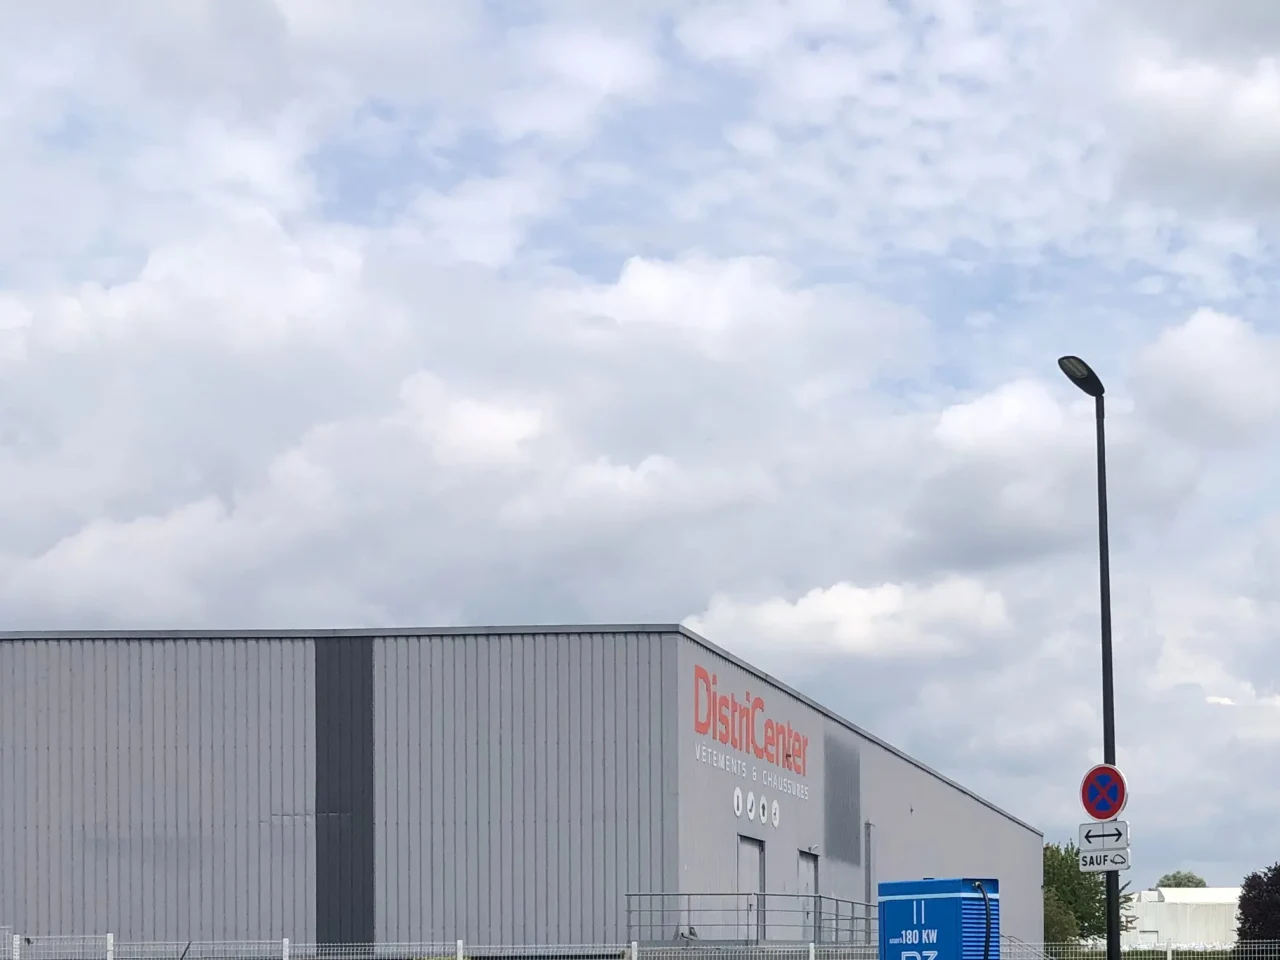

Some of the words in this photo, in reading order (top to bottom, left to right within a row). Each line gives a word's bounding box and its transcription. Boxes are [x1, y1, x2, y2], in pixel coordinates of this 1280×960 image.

[694, 664, 809, 777] DistriCenter
[762, 770, 809, 800] CHAUSSURES
[1082, 855, 1109, 867] SAUF
[901, 929, 919, 944] 180
[922, 929, 938, 944] KW
